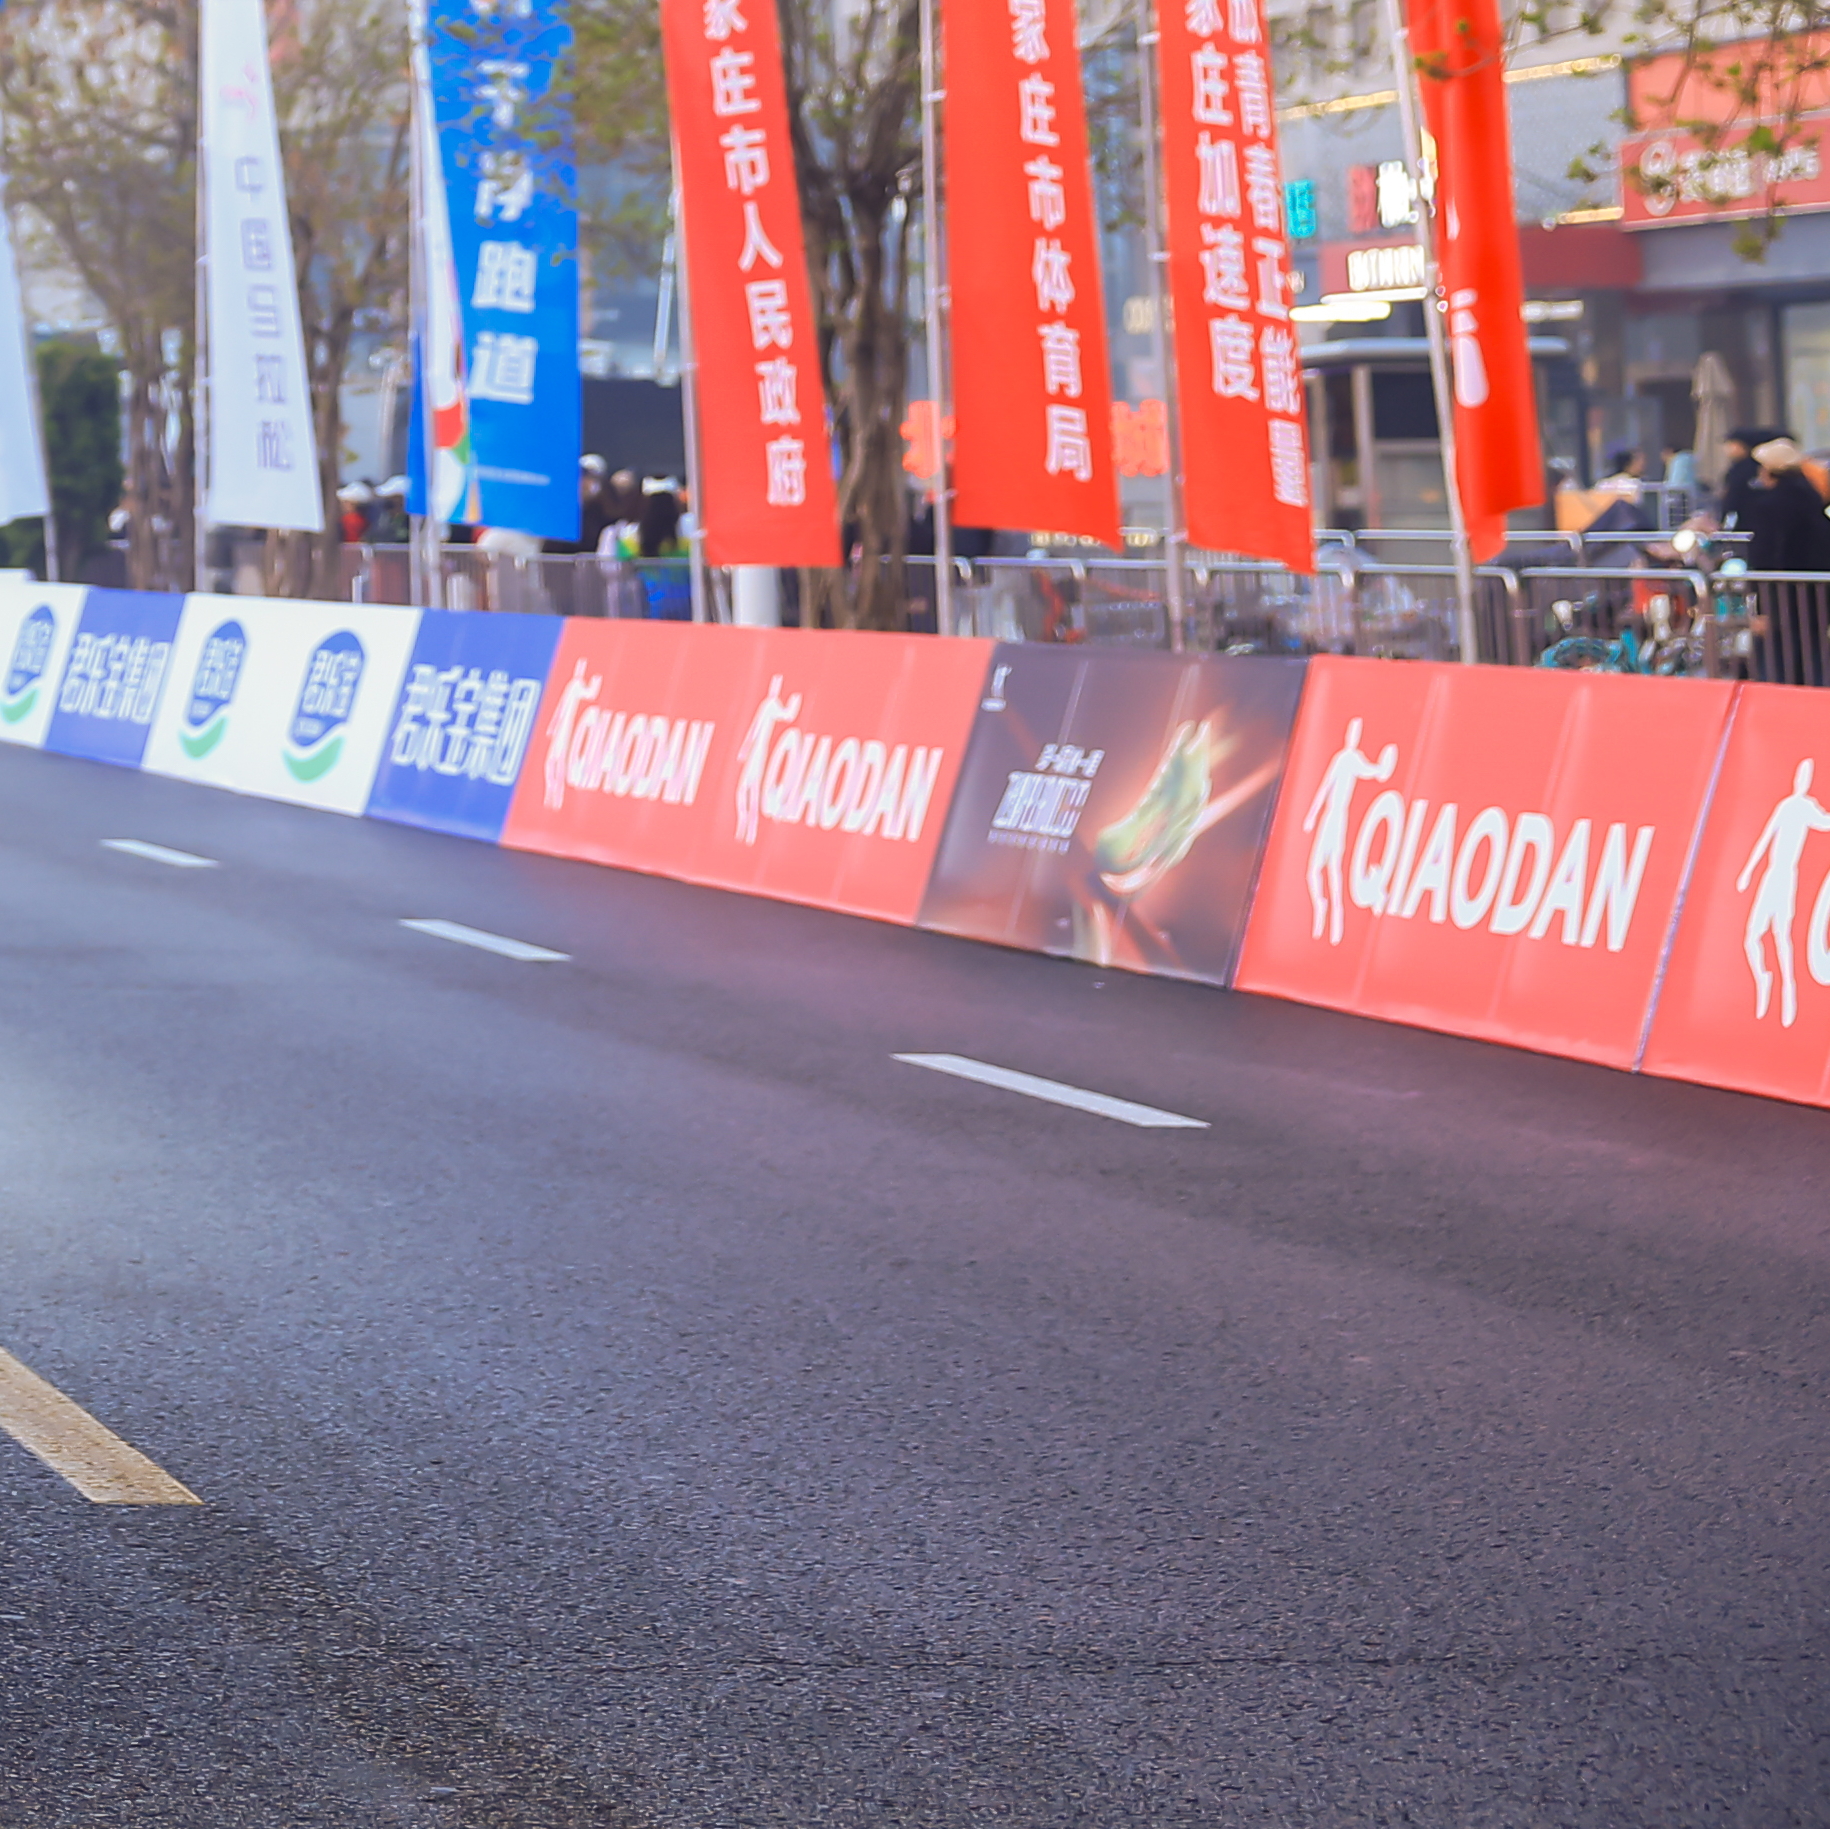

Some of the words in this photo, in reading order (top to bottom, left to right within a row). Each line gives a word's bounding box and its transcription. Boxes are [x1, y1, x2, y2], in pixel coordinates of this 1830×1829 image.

[390, 662, 542, 787] 君乐宝集团
[568, 706, 715, 806] QIAODAN
[761, 728, 943, 843] QIAODAN
[1350, 790, 1655, 953] QIAODAN
